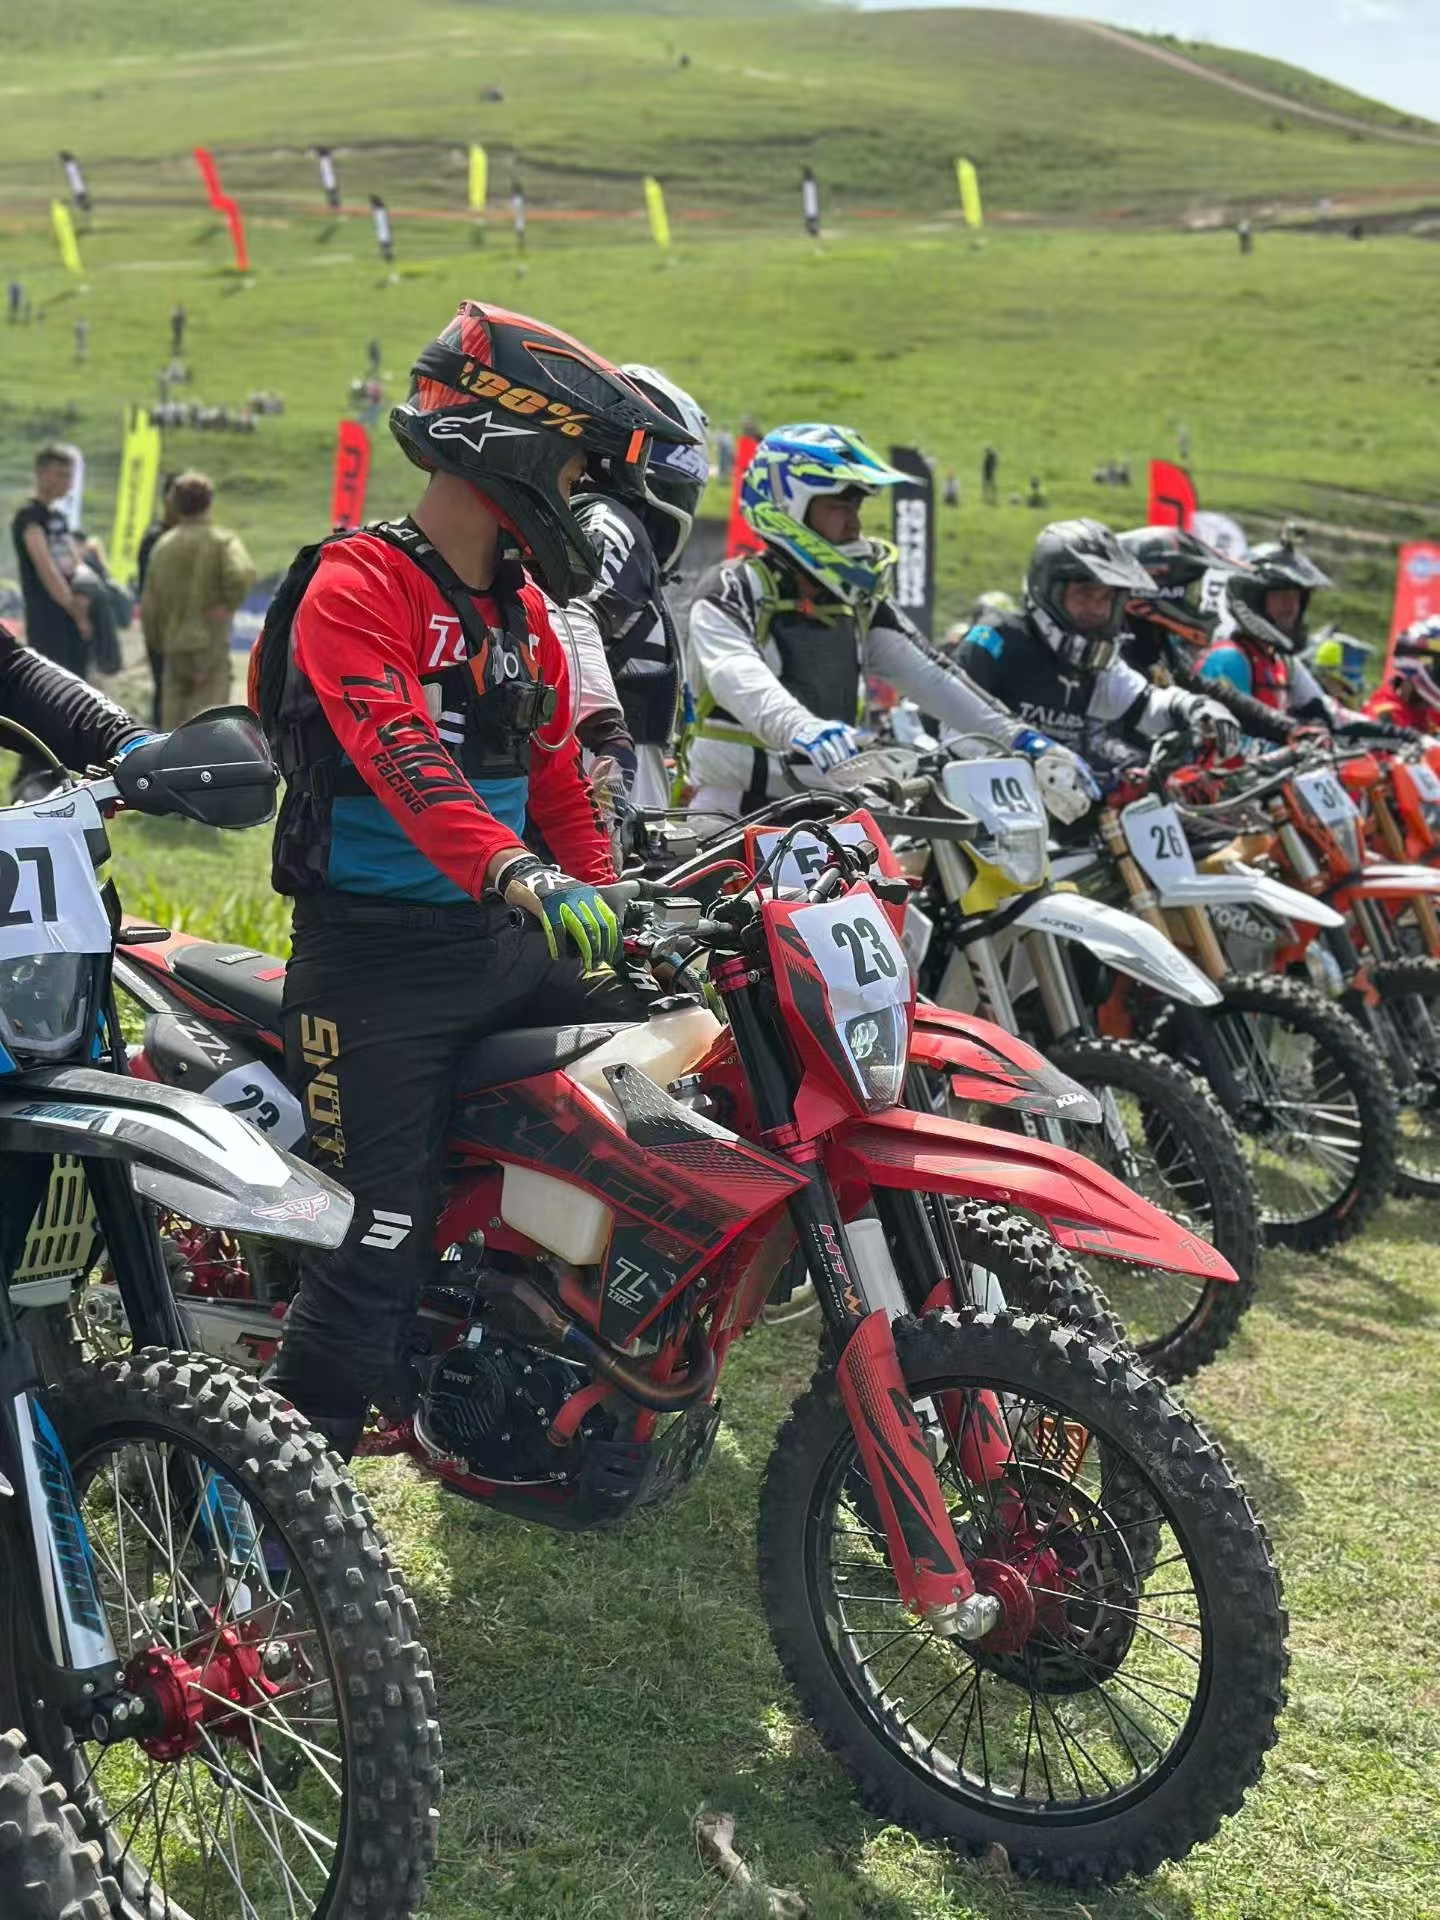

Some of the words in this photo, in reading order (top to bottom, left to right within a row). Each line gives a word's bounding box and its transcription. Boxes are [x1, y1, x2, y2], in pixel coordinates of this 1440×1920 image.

[991, 776, 1032, 812] 49
[1151, 825, 1184, 860] 26
[831, 917, 898, 987] 23
[222, 1084, 280, 1133] 23
[1056, 1092, 1088, 1108] KTM
